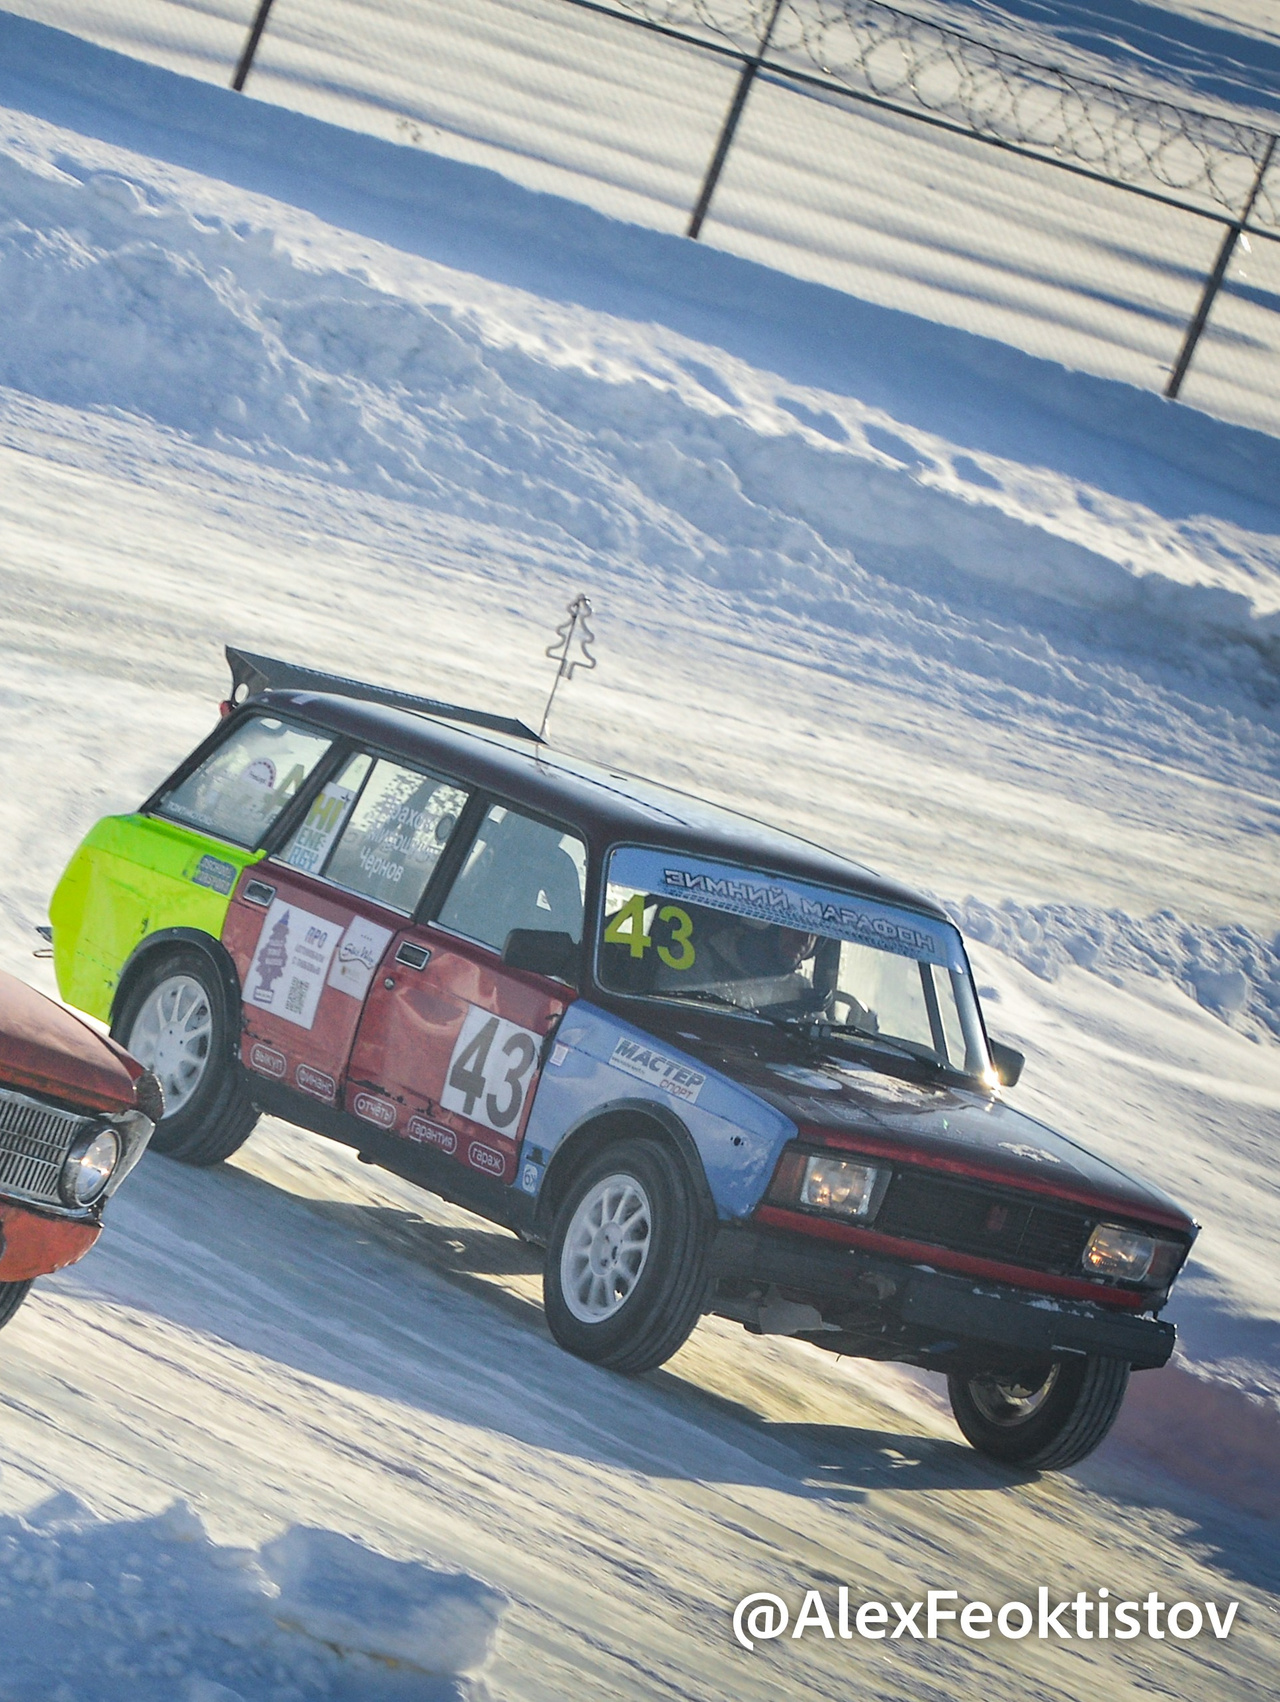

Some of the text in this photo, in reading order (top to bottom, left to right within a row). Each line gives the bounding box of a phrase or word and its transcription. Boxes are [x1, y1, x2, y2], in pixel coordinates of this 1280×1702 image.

[359, 846, 404, 883] Чернов
[663, 868, 936, 954] ЗИМНИЙ МАРАФОН
[604, 894, 696, 971] 43
[254, 1048, 283, 1074] выкуп
[448, 1016, 535, 1129] 43
[617, 1039, 705, 1088] МАСТЕР
[659, 1078, 695, 1100] СПОРТ
[409, 1118, 454, 1151] гарантия
[472, 1144, 502, 1170] гараж
